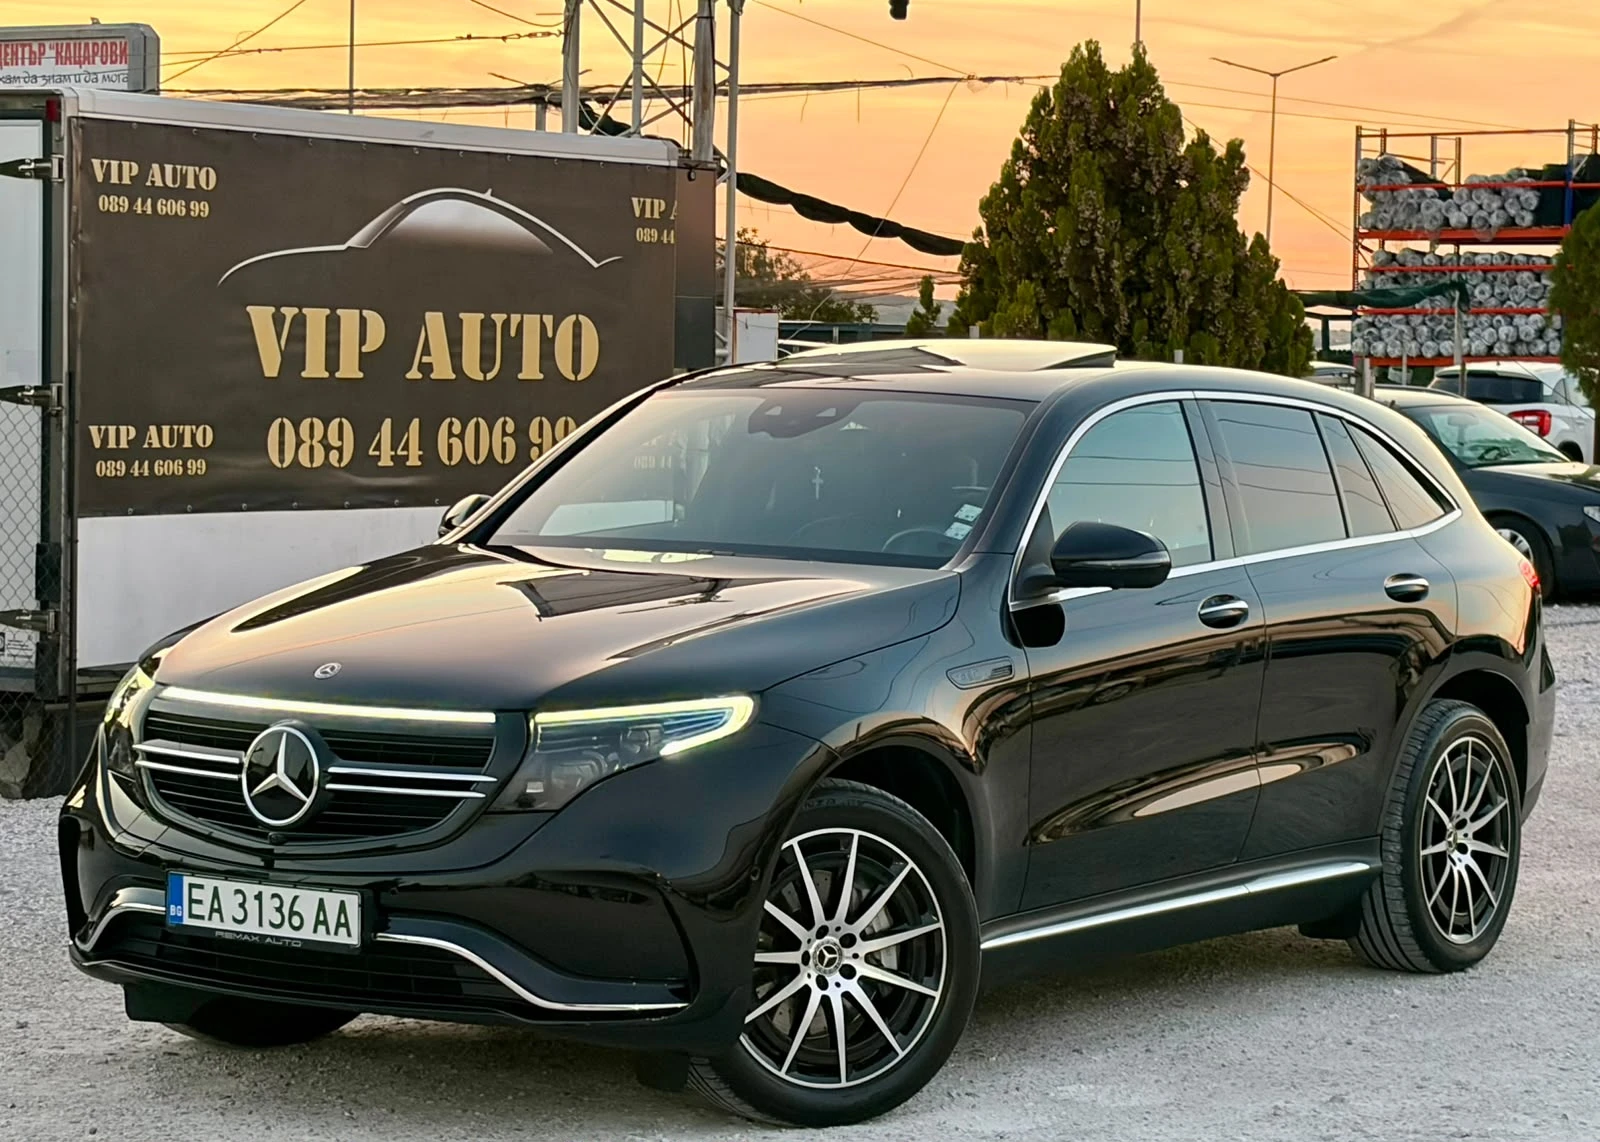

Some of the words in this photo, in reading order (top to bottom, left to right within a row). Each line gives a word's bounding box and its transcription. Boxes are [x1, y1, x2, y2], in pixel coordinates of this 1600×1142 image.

[91, 158, 139, 185] VIP
[145, 163, 217, 190] AUTO
[98, 194, 129, 213] 089
[133, 197, 152, 215] 44
[157, 198, 187, 217] 606
[189, 200, 210, 218] 99
[631, 196, 666, 219] VIP
[636, 227, 659, 243] 089
[246, 305, 387, 379] VIP
[405, 311, 600, 382] AUTO
[88, 424, 137, 449] VIP
[142, 424, 214, 448] AUTO
[266, 416, 355, 469] 089
[368, 417, 424, 467] 44
[437, 416, 517, 466] 606
[95, 459, 127, 477] 089
[129, 459, 150, 477] 44
[153, 459, 184, 476] 606
[186, 458, 207, 475] 99
[169, 904, 183, 916] BG
[214, 930, 260, 943] REMAX
[264, 937, 303, 948] AUTO
